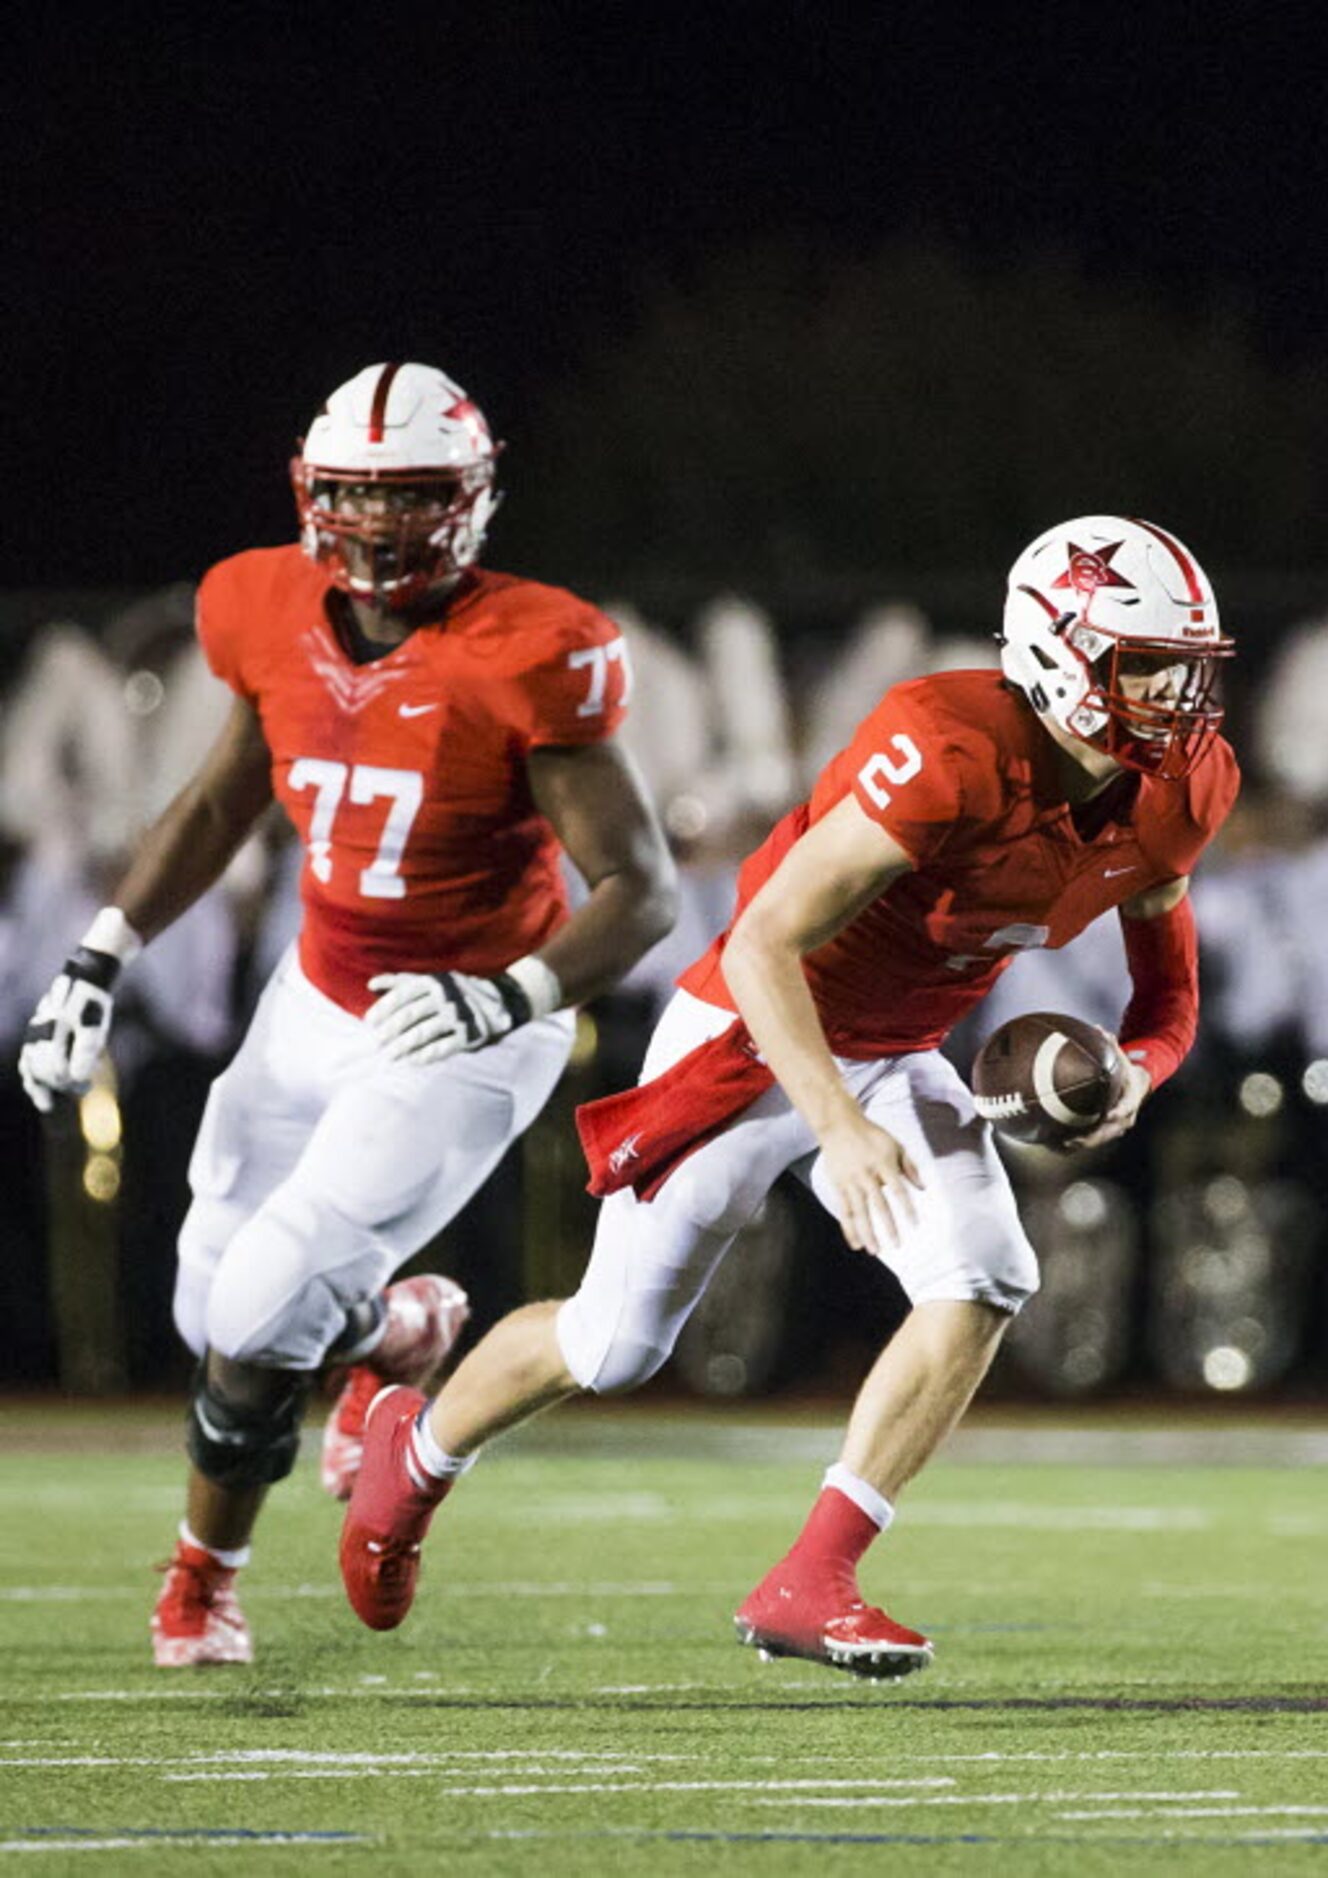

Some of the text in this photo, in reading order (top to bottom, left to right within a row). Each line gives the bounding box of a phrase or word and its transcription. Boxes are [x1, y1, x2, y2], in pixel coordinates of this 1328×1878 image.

[566, 636, 634, 717] 77
[857, 733, 922, 811] 2
[287, 757, 424, 898] 77
